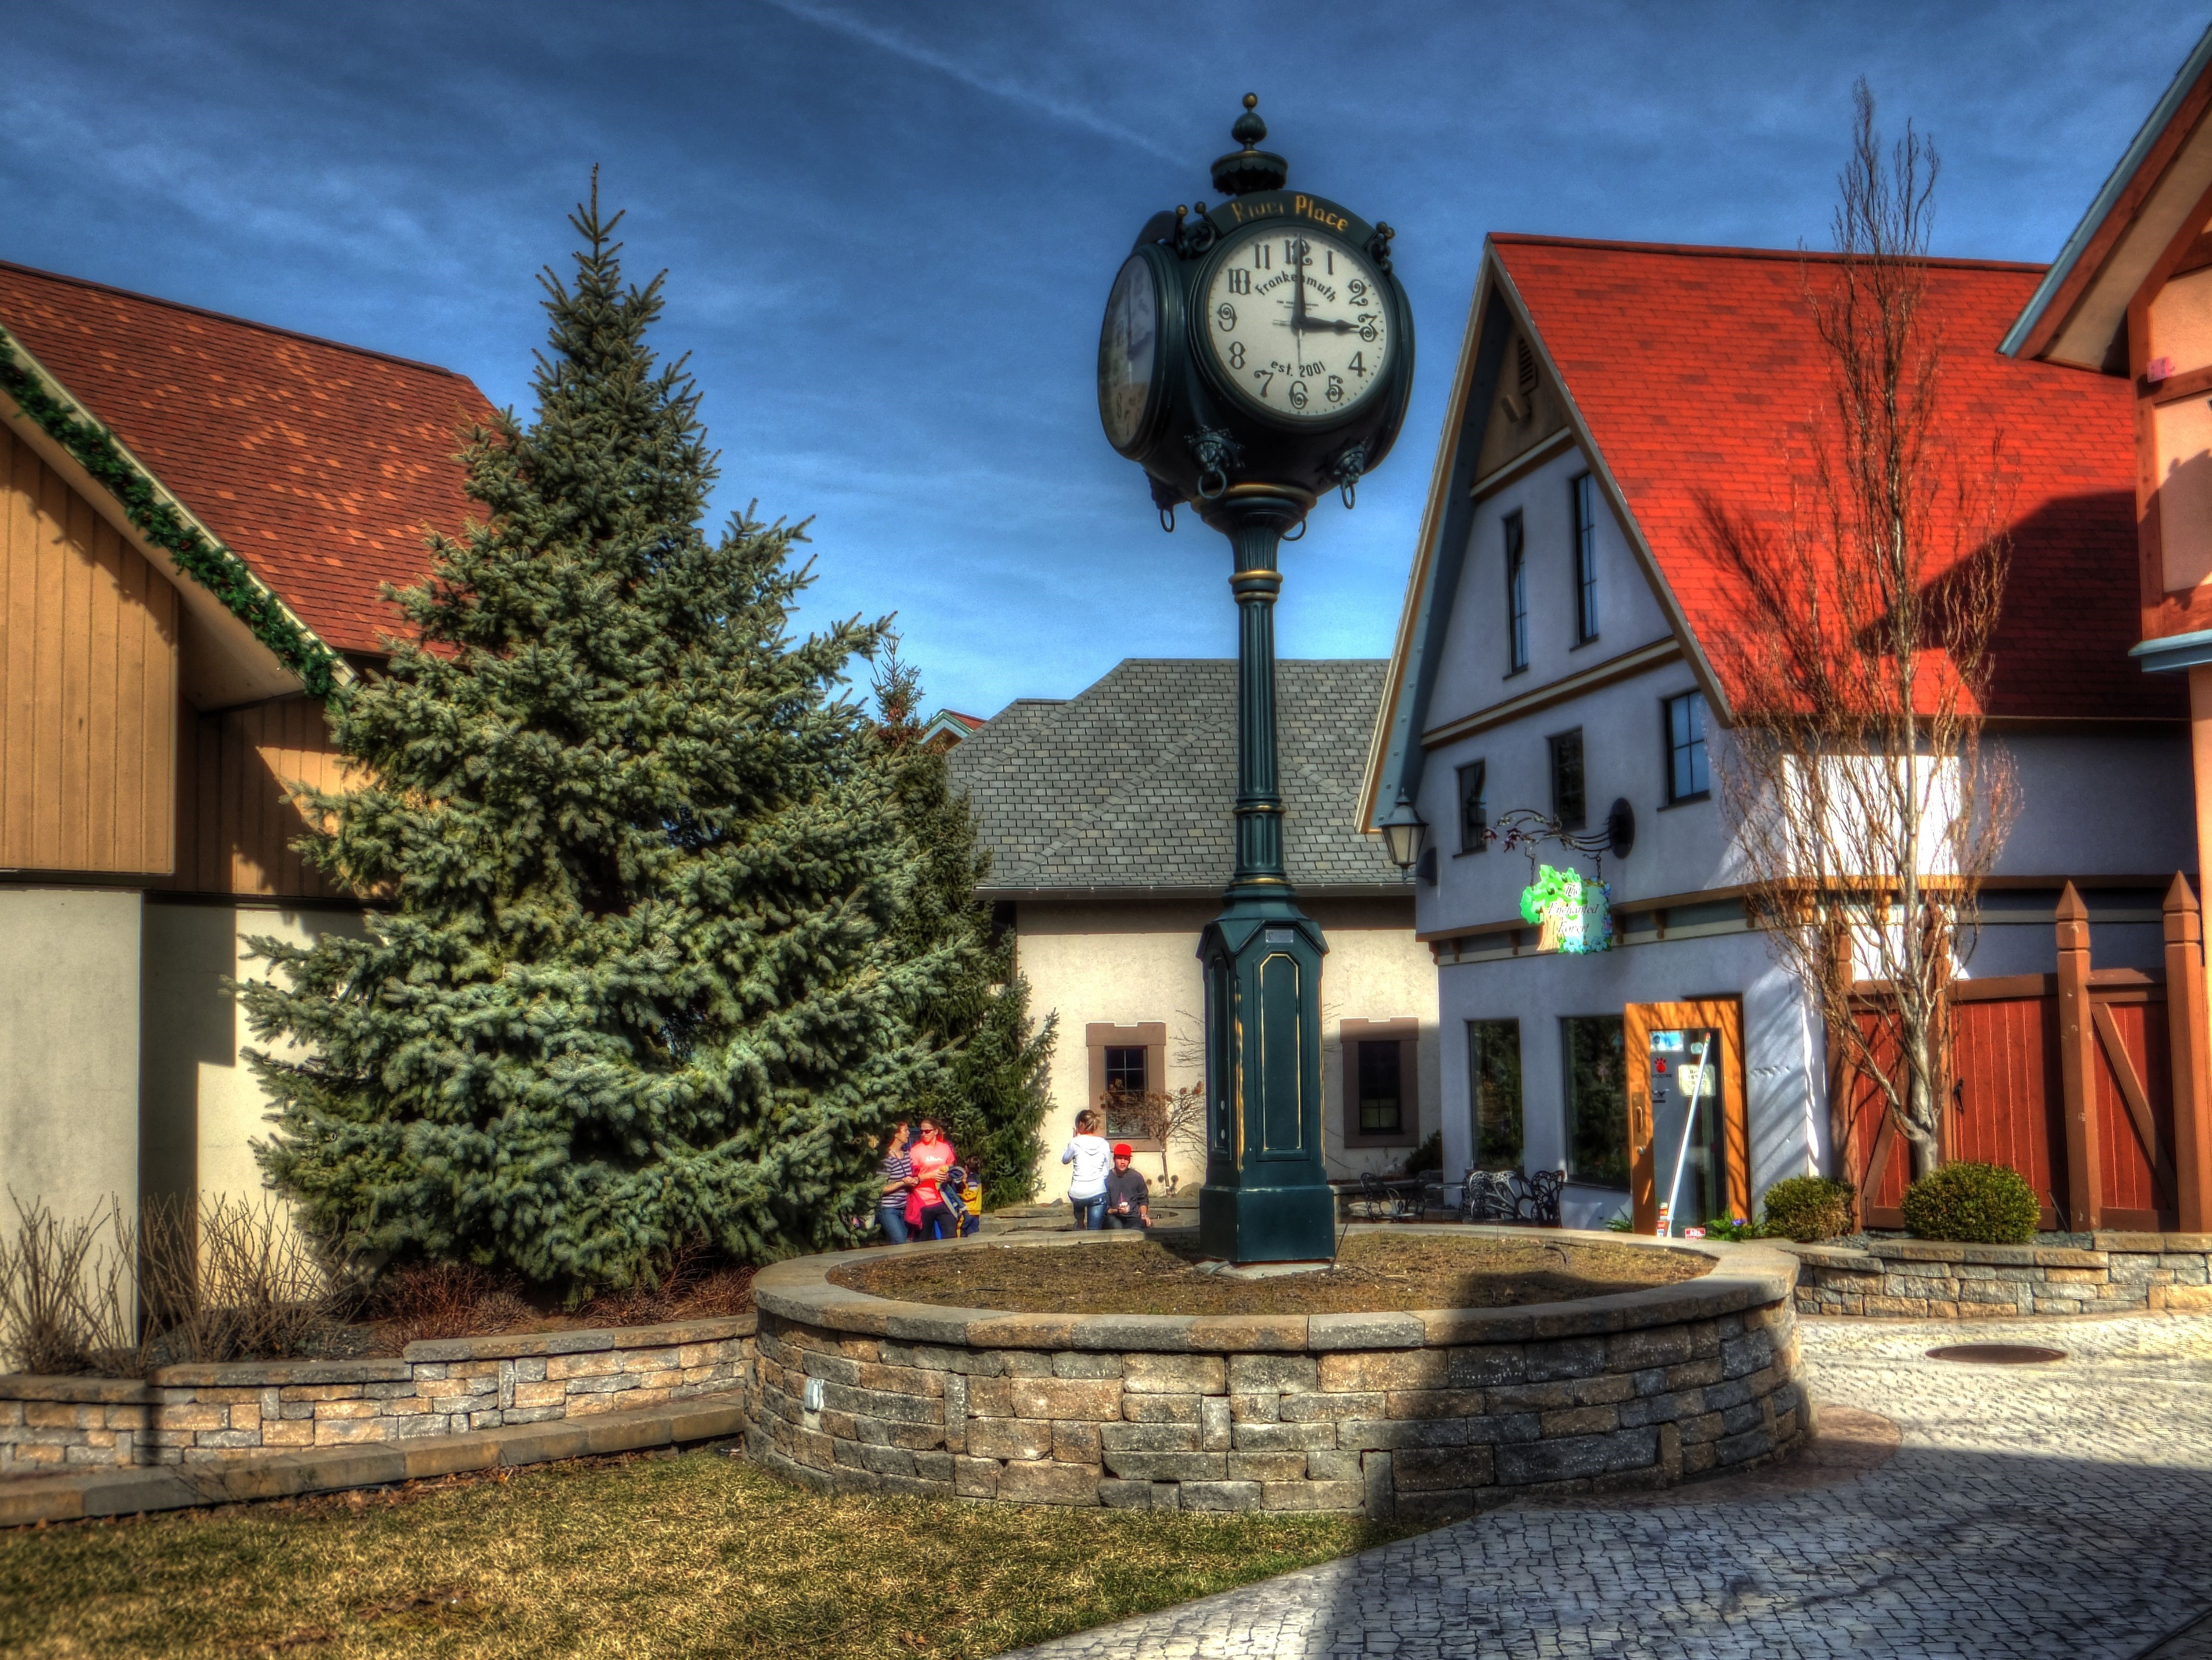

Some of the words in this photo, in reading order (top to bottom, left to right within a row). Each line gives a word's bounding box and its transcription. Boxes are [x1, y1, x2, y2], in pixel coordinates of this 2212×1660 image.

[1295, 195, 1349, 231] Place
[1254, 244, 1271, 270] 11
[1327, 250, 1333, 276] 1
[1228, 268, 1251, 295] 10
[1348, 279, 1369, 306] 2
[1217, 303, 1237, 332] 9
[1357, 313, 1379, 342] 3
[1229, 341, 1246, 369] 8
[1348, 351, 1368, 378] 4
[1271, 361, 1293, 377] est.
[1299, 361, 1326, 378] 2001
[1254, 369, 1273, 398] 7
[1289, 381, 1309, 409] 6
[1325, 375, 1344, 403] 5
[1564, 883, 1580, 897] The
[1548, 903, 1600, 915] Enchanted
